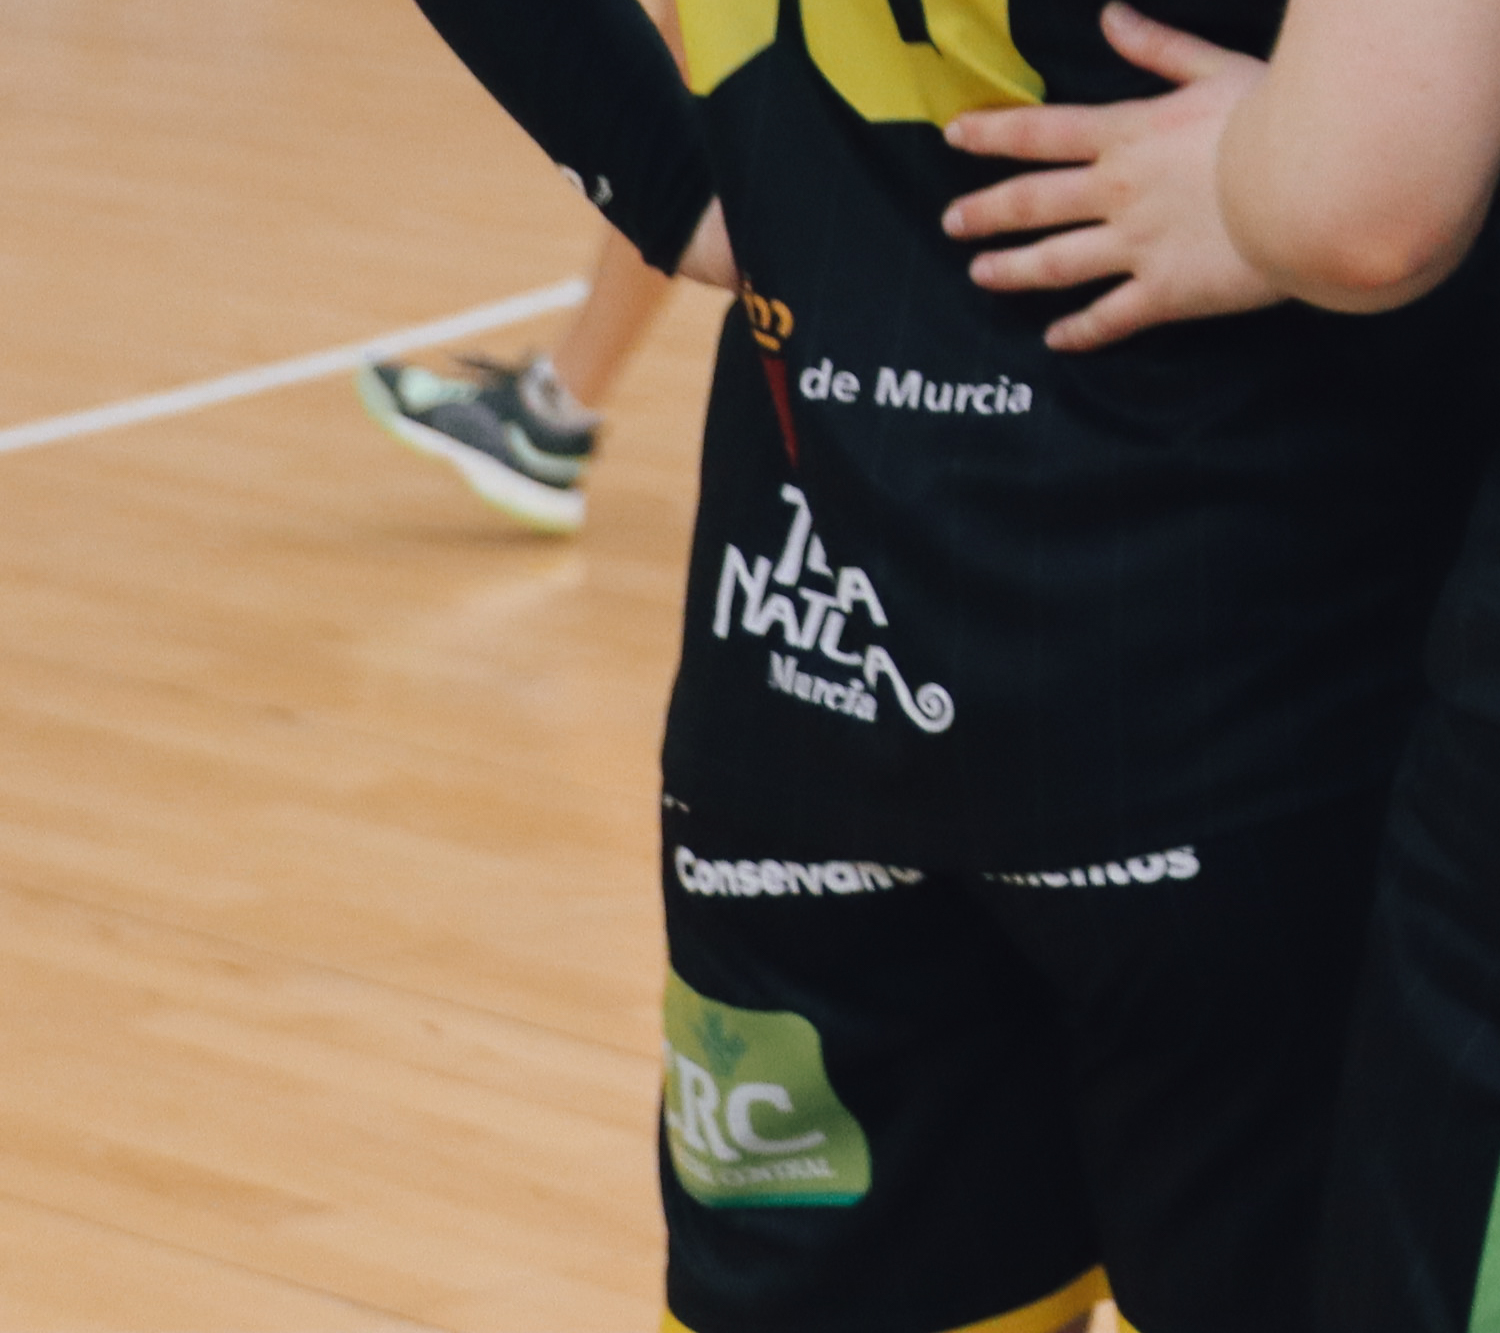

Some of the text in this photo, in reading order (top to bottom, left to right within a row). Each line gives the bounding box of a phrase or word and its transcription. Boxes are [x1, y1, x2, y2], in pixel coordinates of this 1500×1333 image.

[799, 357, 1033, 416] de Murcia
[767, 650, 879, 723] Murcia
